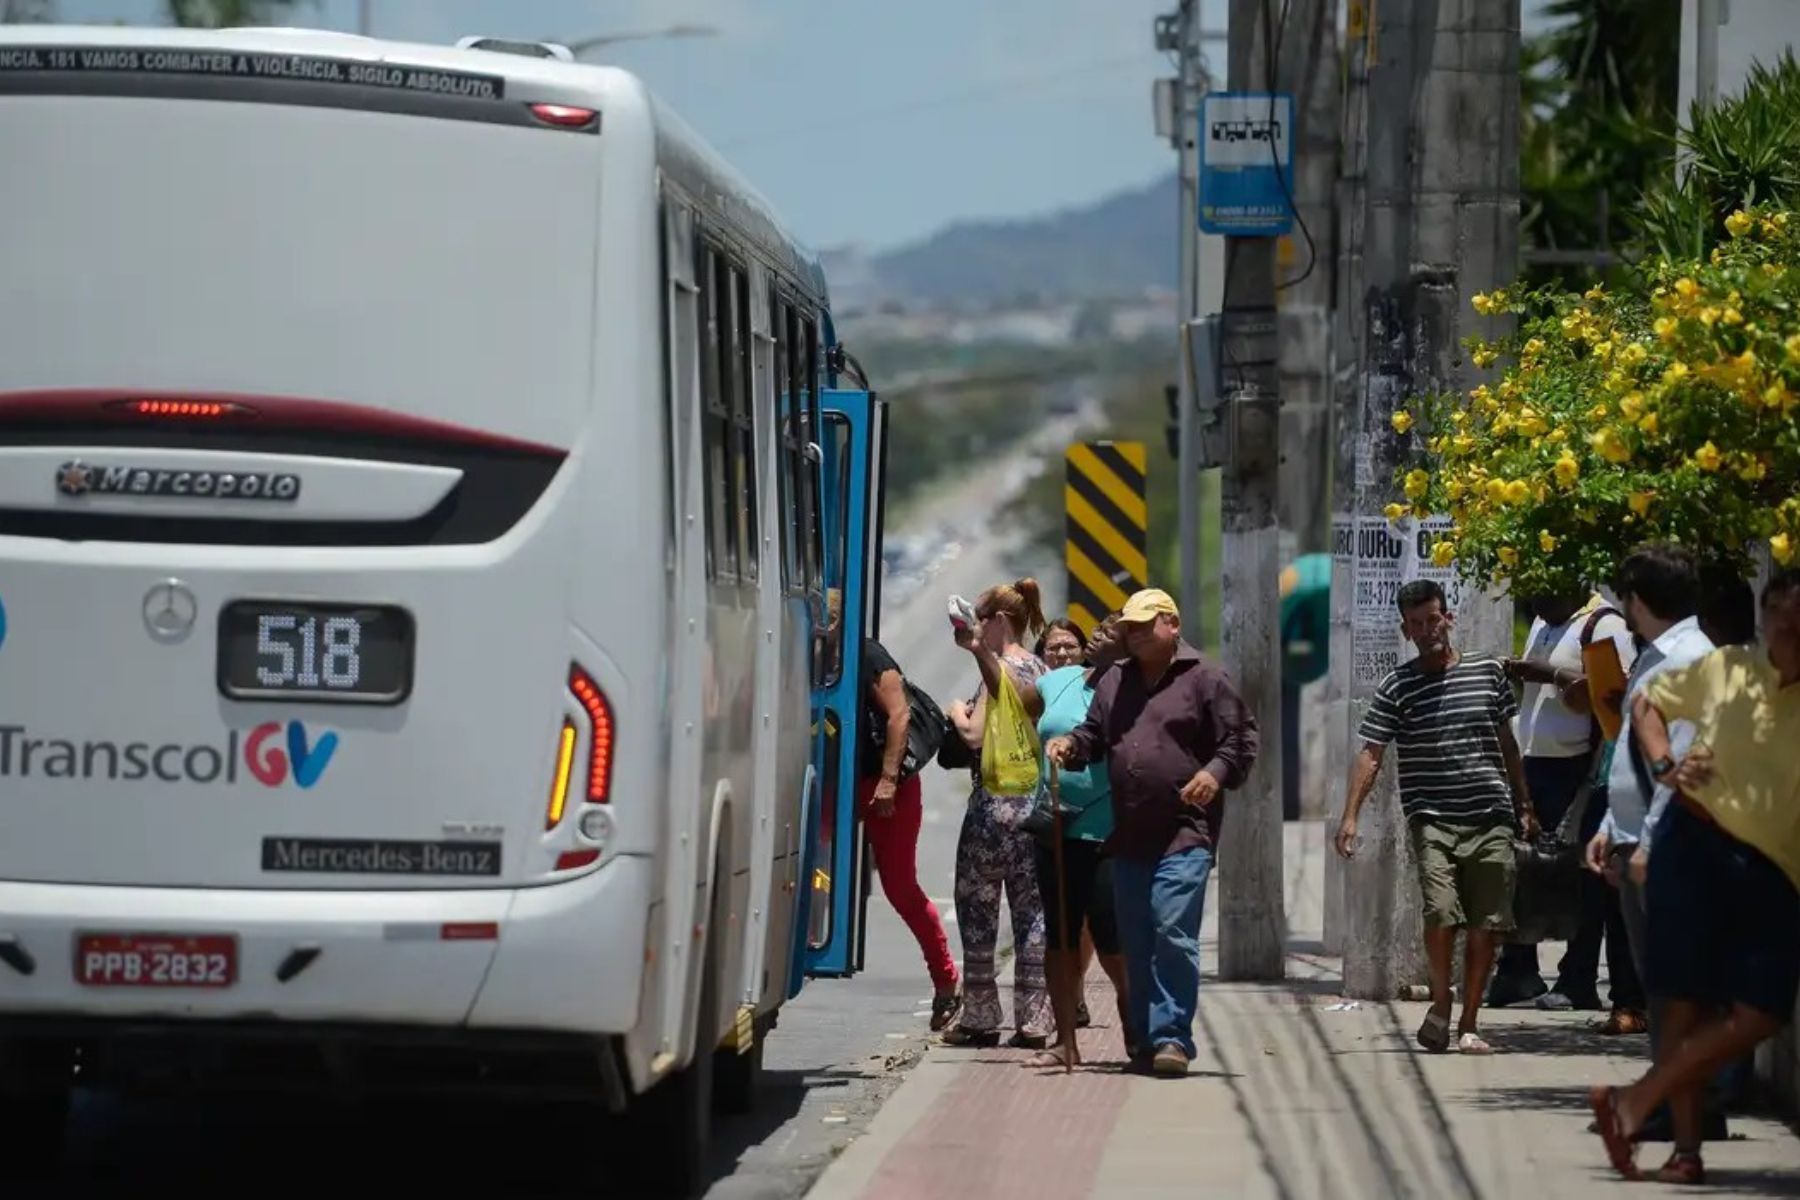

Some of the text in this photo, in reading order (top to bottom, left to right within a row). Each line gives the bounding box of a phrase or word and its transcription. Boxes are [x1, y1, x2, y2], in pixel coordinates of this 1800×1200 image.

[49, 52, 75, 67] 181
[81, 52, 138, 68] VAMOS
[143, 53, 231, 71] COMBATER
[236, 56, 248, 72] A
[349, 65, 401, 84] SIGILO
[101, 466, 298, 498] Marcopolo
[257, 615, 360, 687] 518
[274, 841, 492, 872] Mercedes-Benz
